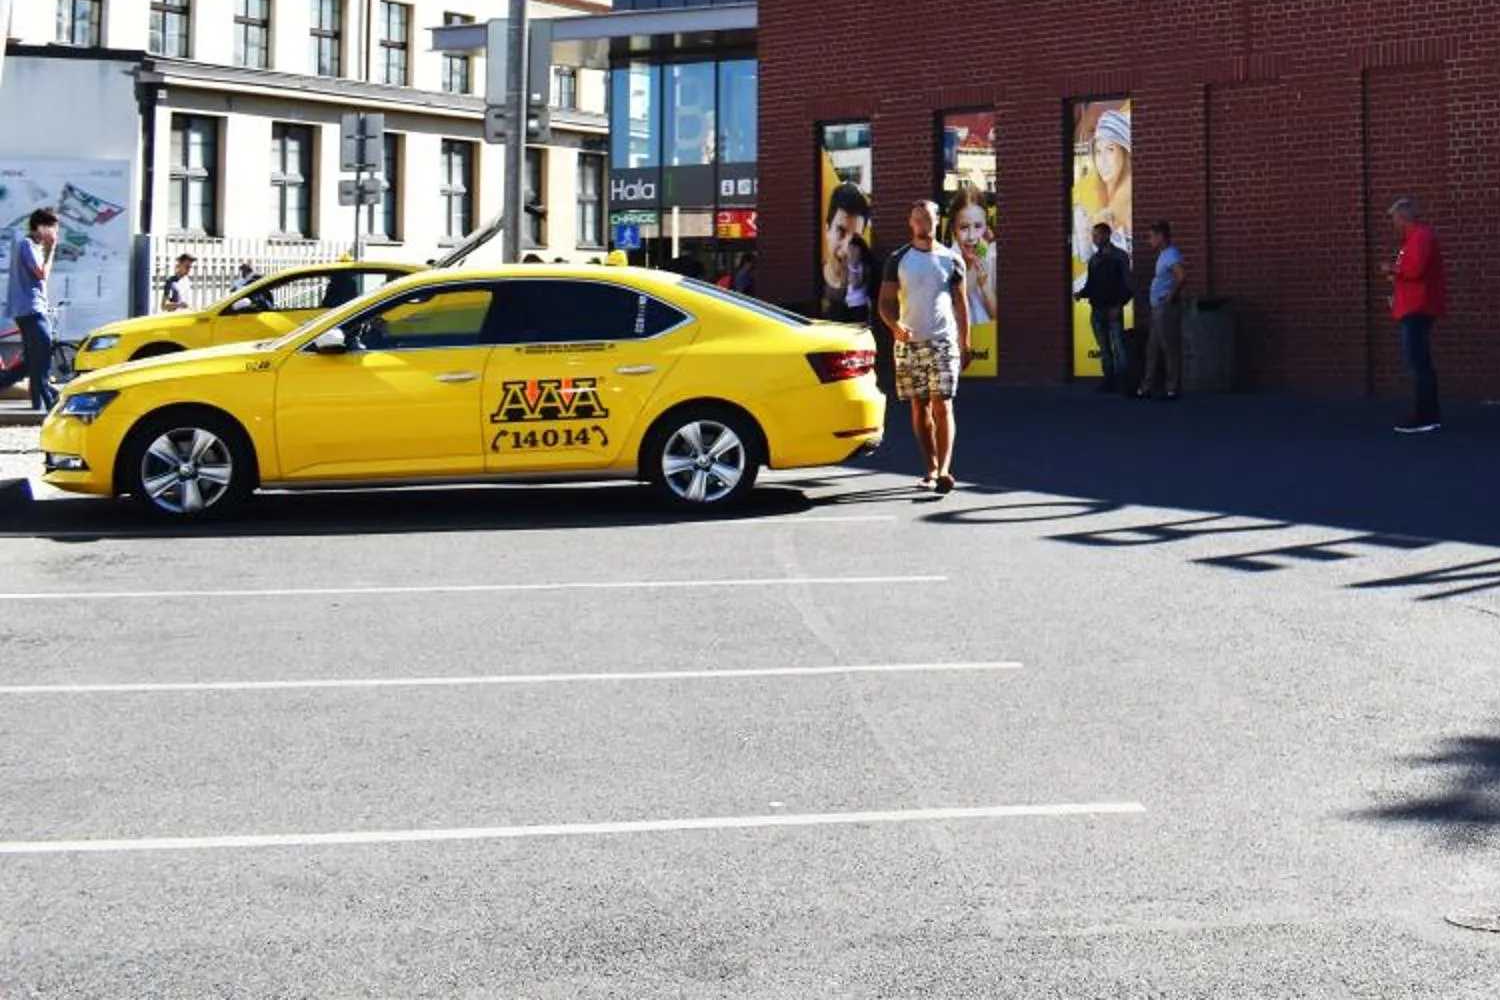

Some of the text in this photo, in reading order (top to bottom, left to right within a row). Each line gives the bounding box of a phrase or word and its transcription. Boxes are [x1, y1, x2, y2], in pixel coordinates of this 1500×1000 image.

[611, 179, 655, 200] Hala
[490, 377, 608, 423] AAA
[512, 428, 590, 448] 14014
